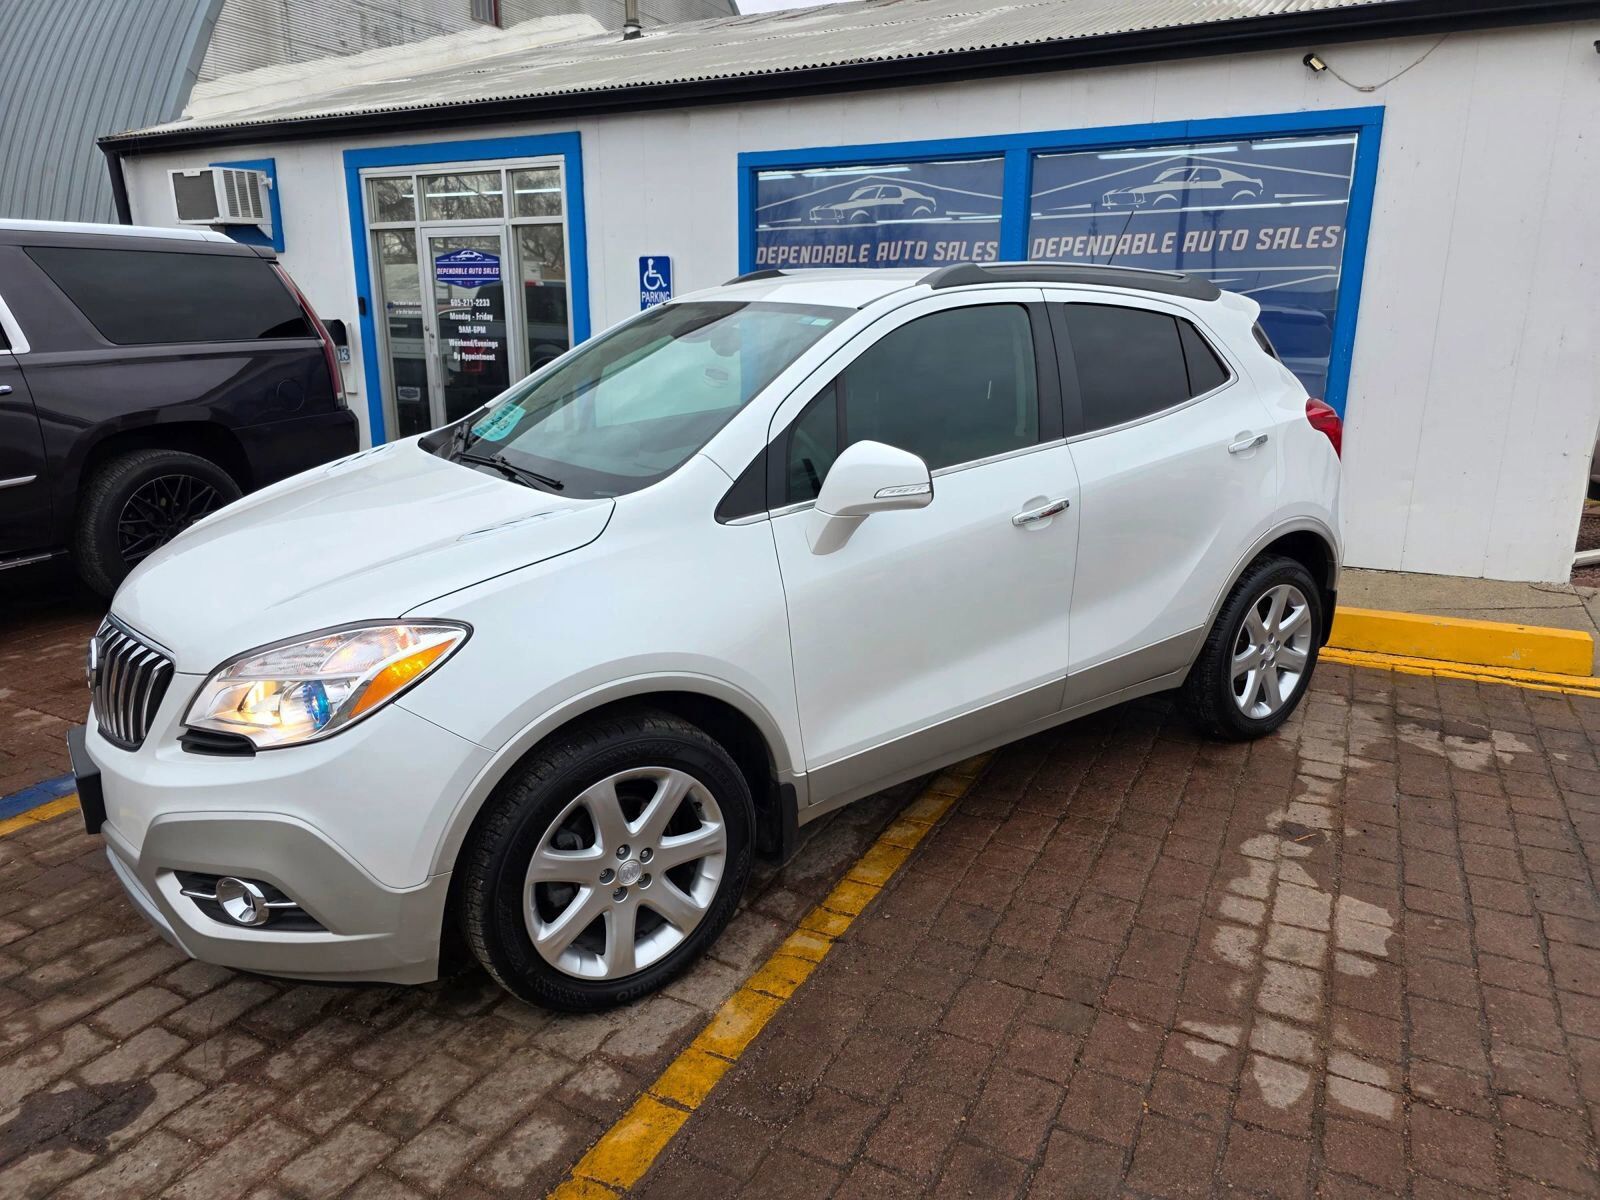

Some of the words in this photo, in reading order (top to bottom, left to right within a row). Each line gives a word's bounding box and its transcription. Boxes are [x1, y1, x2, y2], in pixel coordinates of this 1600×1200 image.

[1031, 231, 1177, 259] DEPENDABLE
[1182, 229, 1249, 252] AUTO
[1255, 225, 1341, 250] SALES
[756, 243, 870, 265] DEPENDABLE
[876, 241, 928, 261] AUTO
[933, 240, 999, 261] SALES
[437, 267, 467, 275] DEPENDABLE
[469, 267, 482, 275] AUTO
[483, 267, 499, 275] SALES
[642, 291, 670, 302] PARKING
[449, 312, 471, 322] Monday
[476, 312, 494, 322] Friday
[449, 339, 498, 349] Weekend/Evenings
[454, 352, 460, 361] By
[462, 352, 495, 361] Appointment
